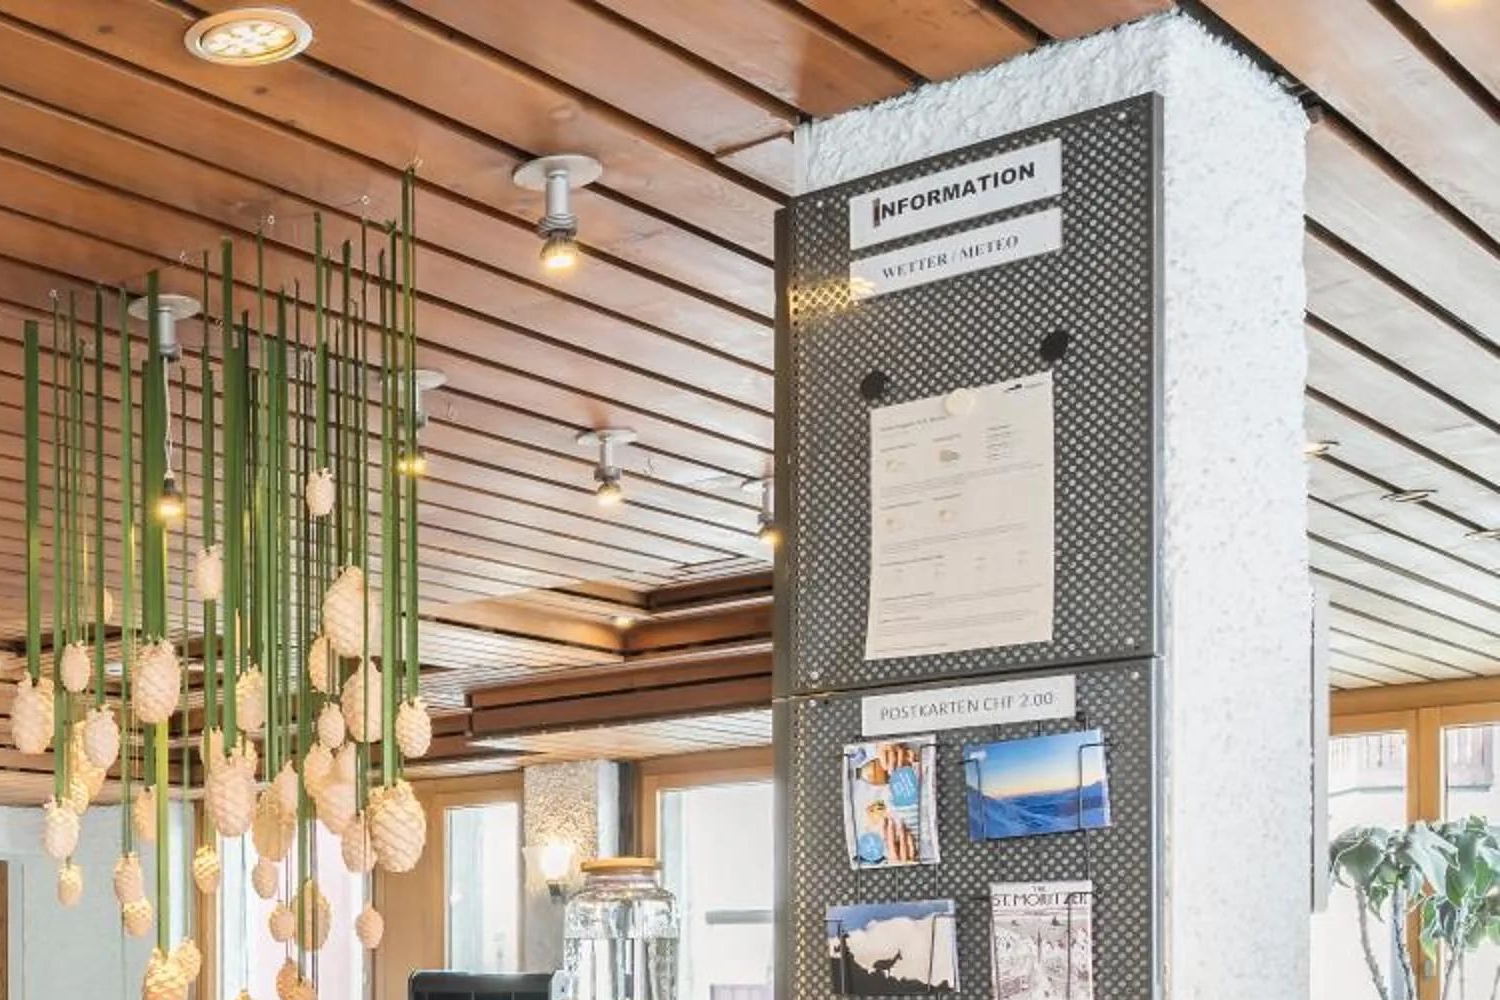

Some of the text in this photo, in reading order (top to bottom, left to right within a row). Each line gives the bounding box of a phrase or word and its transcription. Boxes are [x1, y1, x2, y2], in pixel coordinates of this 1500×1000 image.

[872, 161, 1036, 228] INFORMATION
[882, 252, 948, 280] WETTER
[959, 234, 1020, 261] METEO
[880, 691, 1054, 721] POSTKARTEN CHF 2.00
